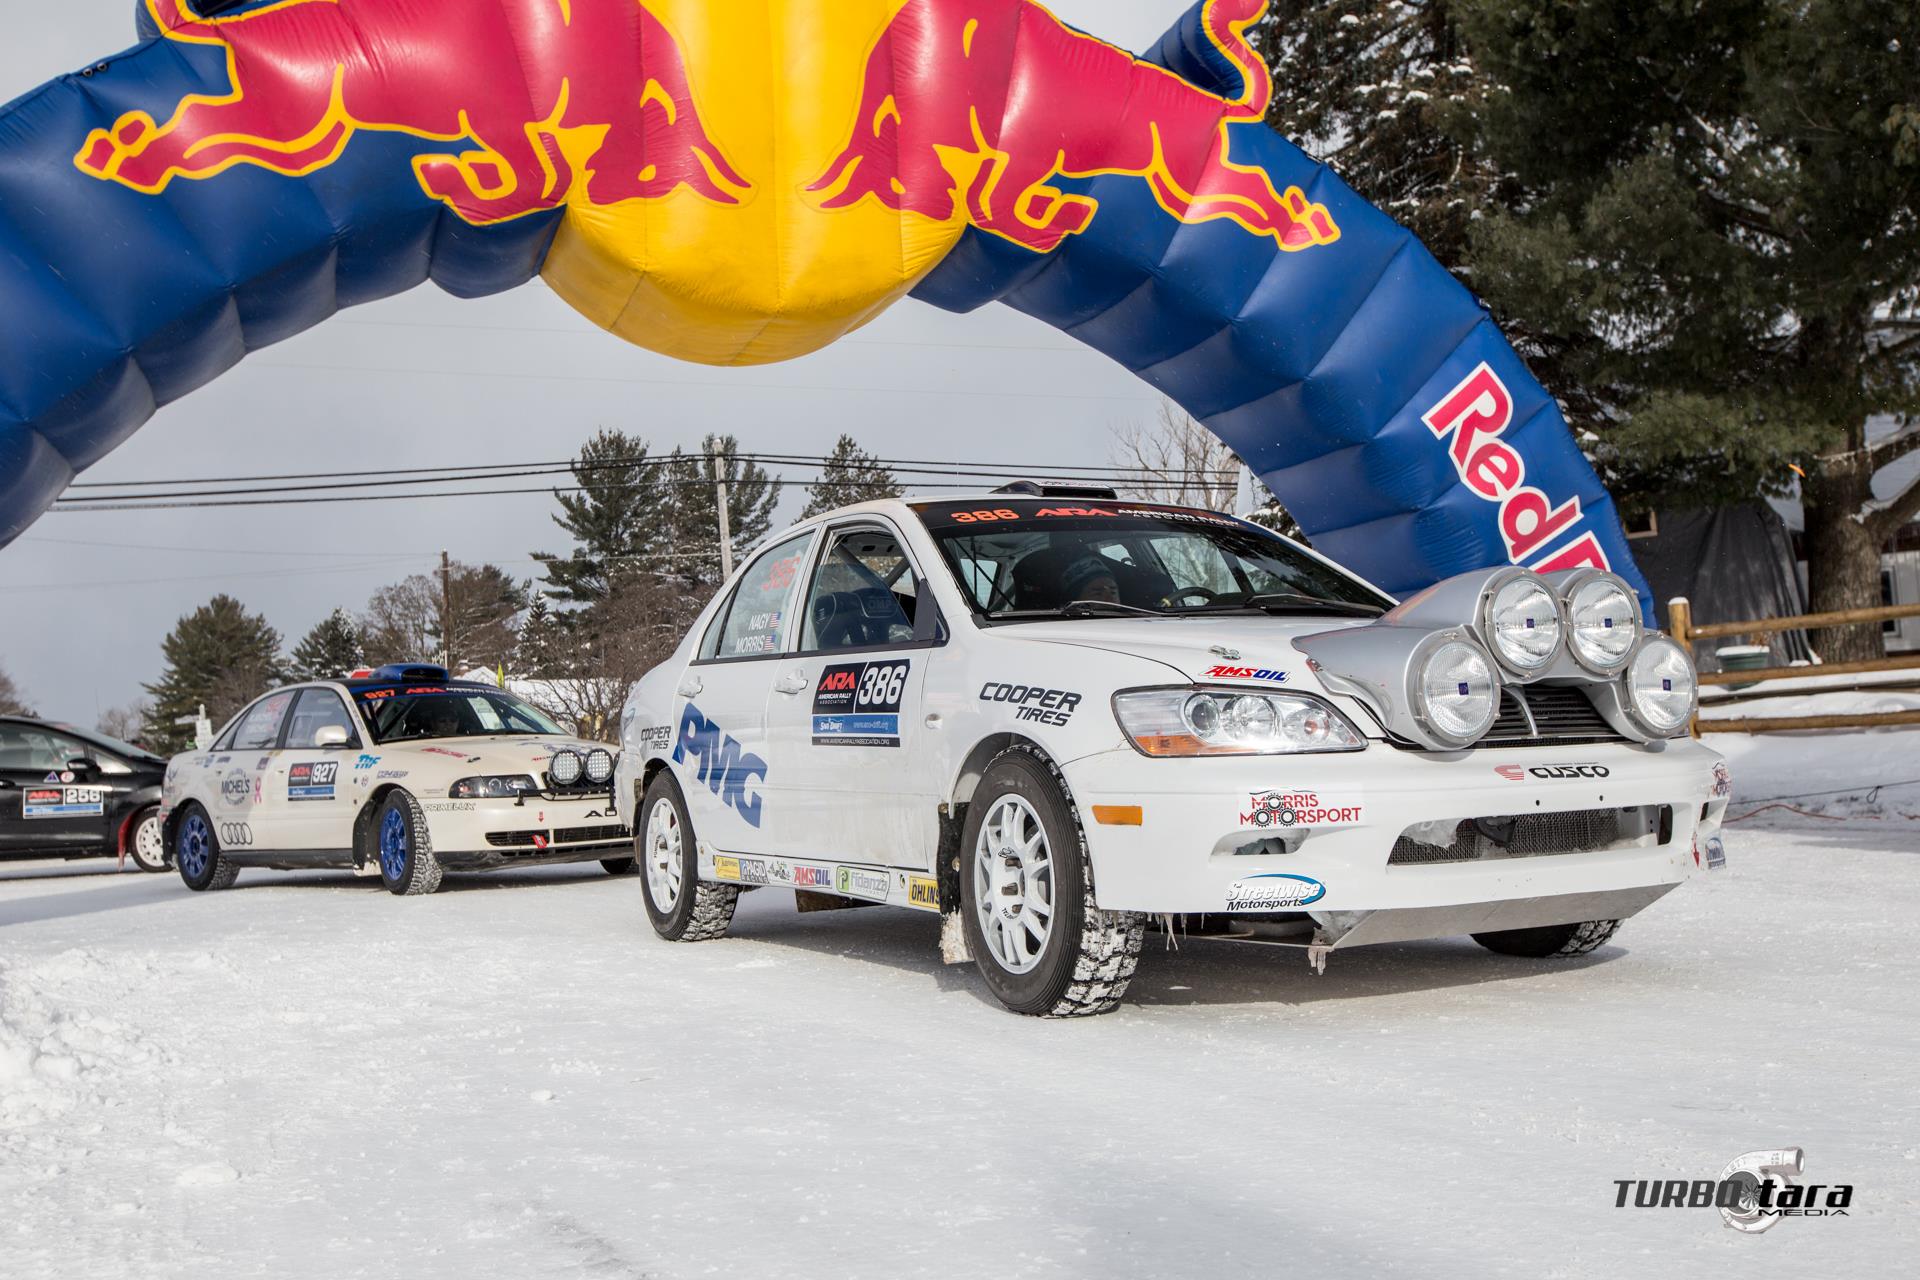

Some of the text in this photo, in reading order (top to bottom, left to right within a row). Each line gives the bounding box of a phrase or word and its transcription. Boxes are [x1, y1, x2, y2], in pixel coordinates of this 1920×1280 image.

[1421, 361, 1584, 565] Red
[951, 508, 1020, 523] 386
[1035, 507, 1120, 518] ARA
[749, 614, 772, 630] NAGY
[734, 635, 766, 653] MORRIS
[1204, 665, 1290, 682] AMSOIL
[364, 689, 395, 699] 927
[819, 665, 907, 705] ARA 386
[979, 682, 1083, 713] COOPER
[1014, 706, 1072, 727] TIRES
[641, 726, 672, 741] COOPER
[650, 740, 669, 750] TIRES
[290, 763, 338, 783] ARA 927
[672, 702, 768, 829] PMG
[1528, 765, 1610, 779] CUSCO
[221, 779, 250, 794] MICHEL'S
[1251, 794, 1319, 811] MORRIS
[1240, 807, 1362, 828] MOTORSPORT
[793, 867, 831, 886] AMSOIL
[911, 879, 940, 904] ÖHLINS
[1226, 882, 1321, 902] Streetwise
[1227, 900, 1304, 912] Motorsports
